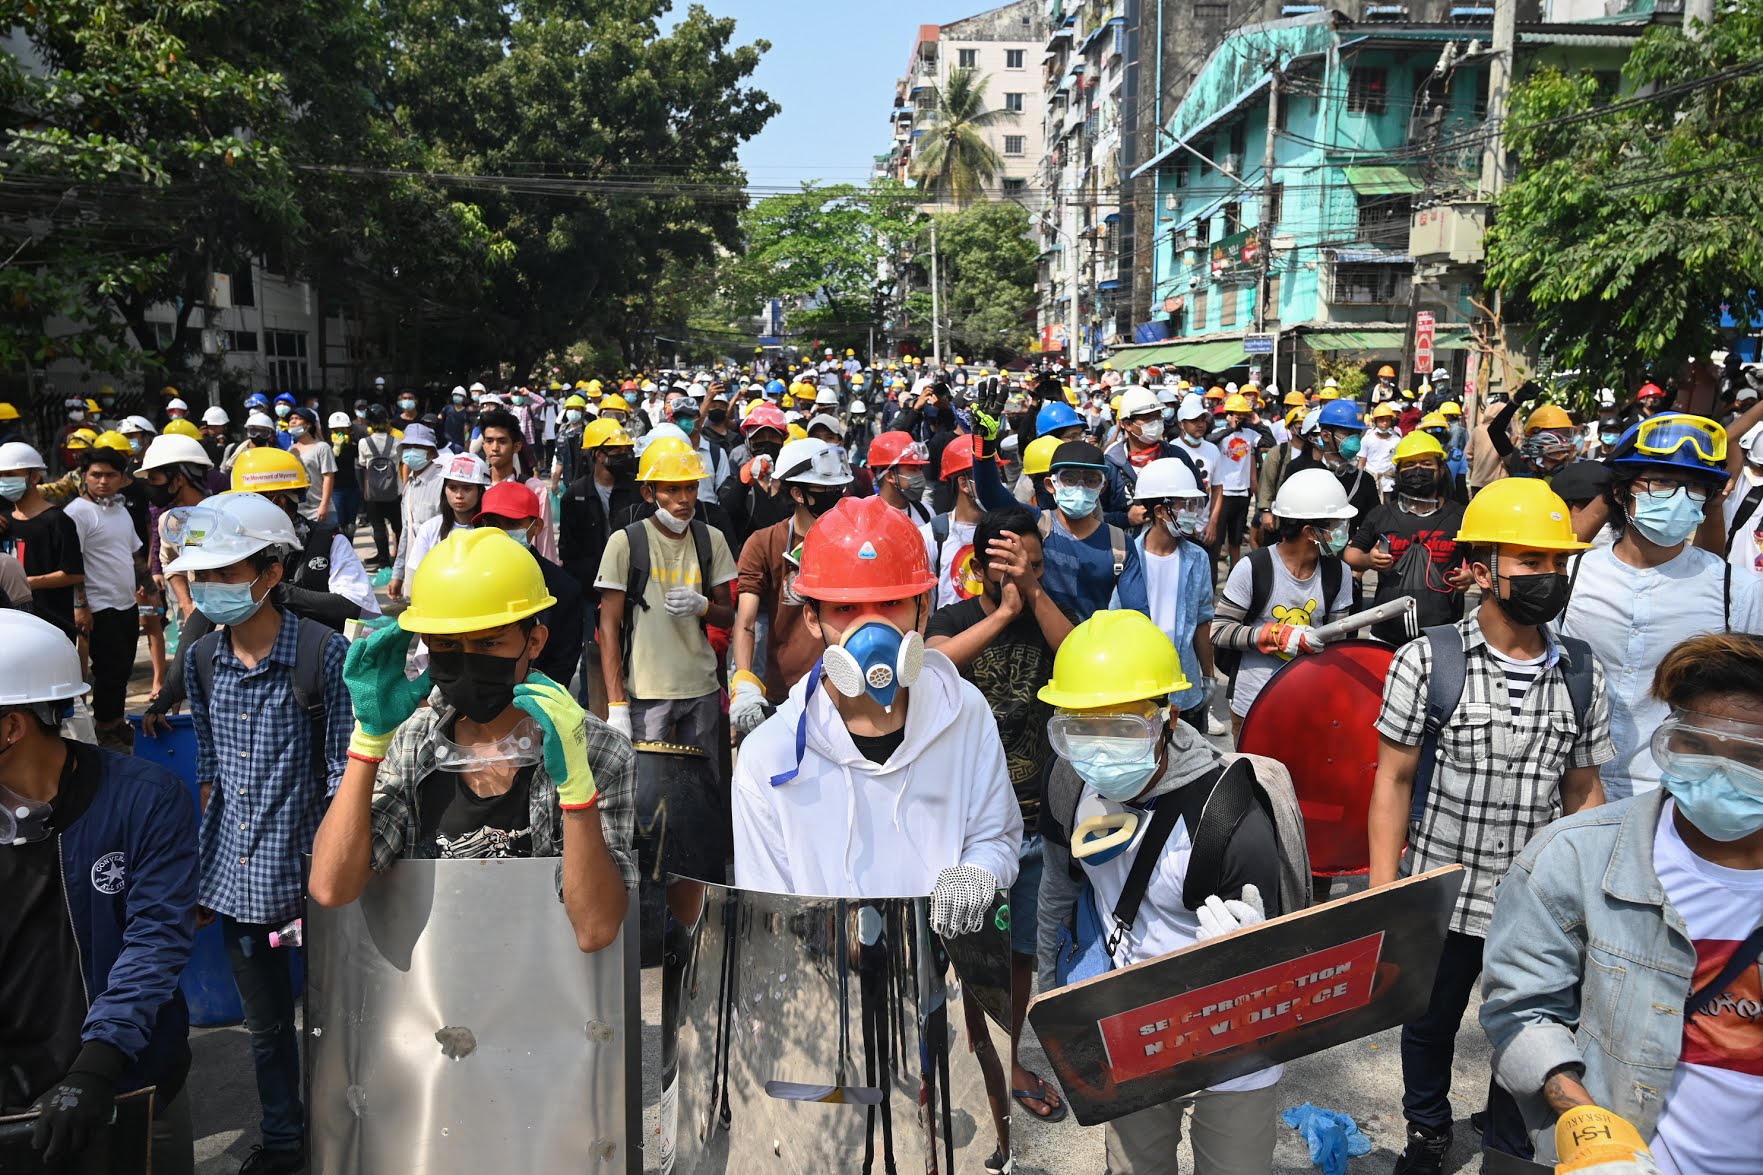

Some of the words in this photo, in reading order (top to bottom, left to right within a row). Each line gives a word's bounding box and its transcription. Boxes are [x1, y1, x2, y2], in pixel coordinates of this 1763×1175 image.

[96, 855, 125, 872] CONVER
[1139, 961, 1352, 1036] SEF-PROTETION
[1209, 982, 1348, 1036] VOLECE
